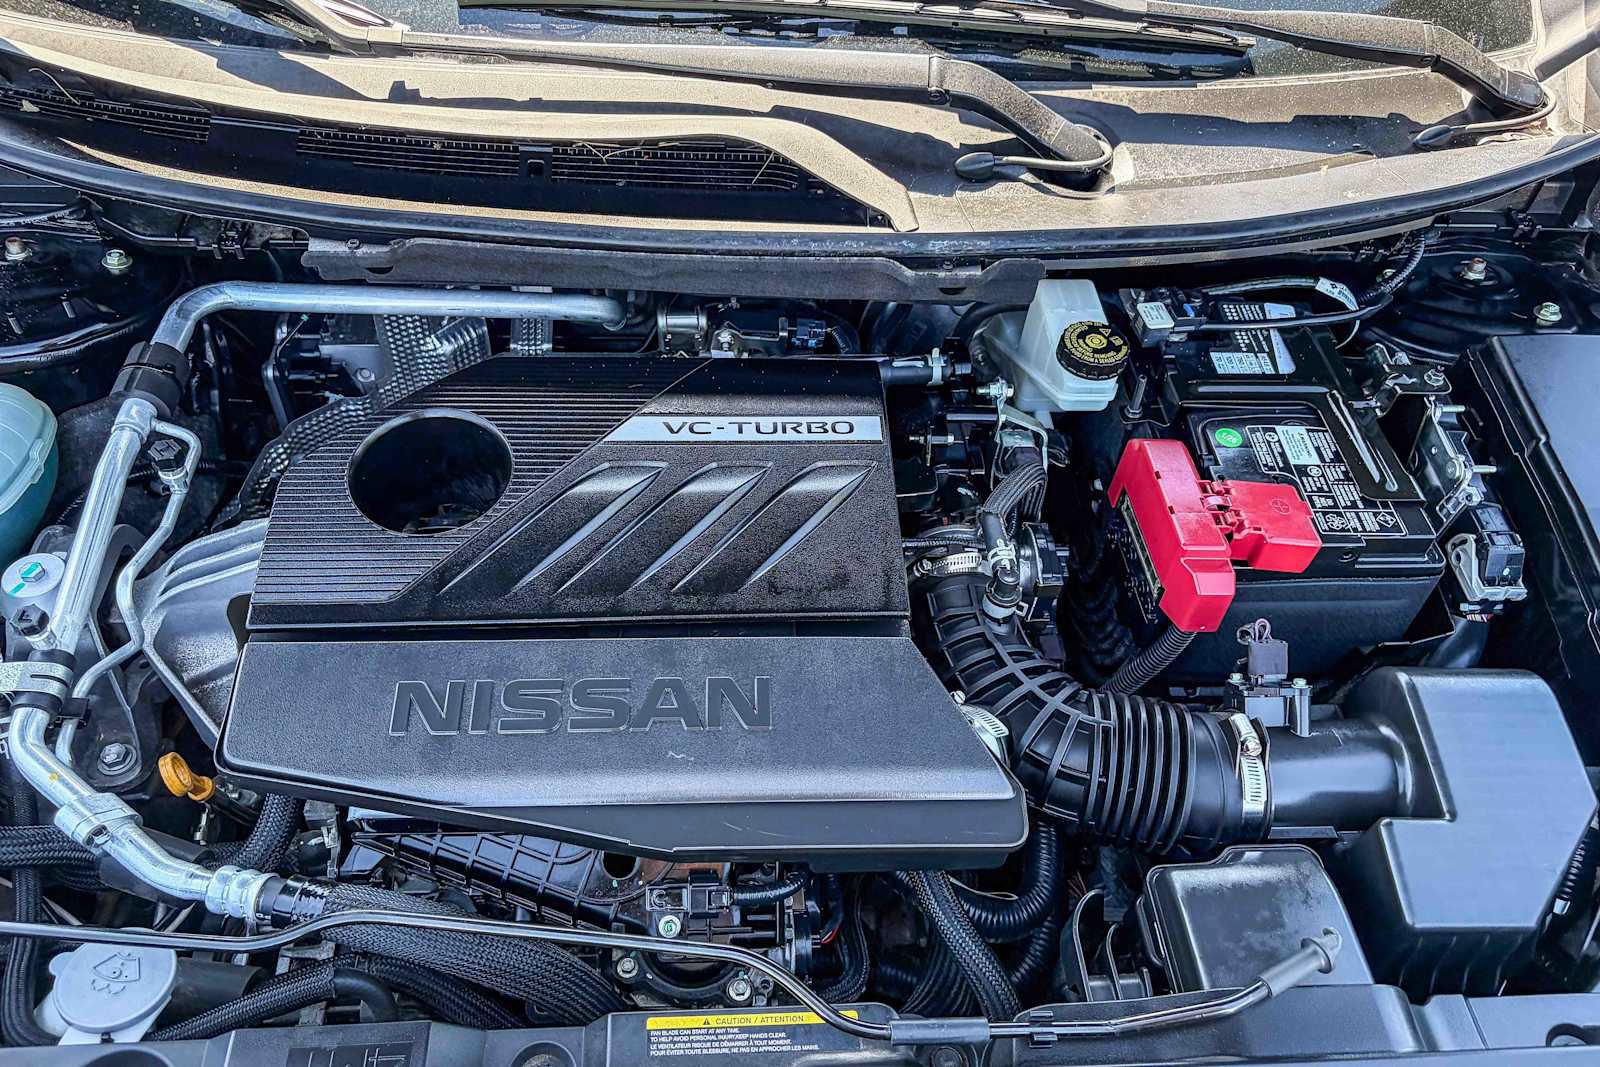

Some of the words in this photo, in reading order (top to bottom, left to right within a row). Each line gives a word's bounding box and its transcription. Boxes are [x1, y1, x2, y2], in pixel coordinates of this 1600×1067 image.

[662, 421, 855, 435] VC-TURBO
[389, 676, 773, 735] NISSAN
[715, 1017, 752, 1025] CAUTION
[760, 1016, 804, 1024] ATTENTION
